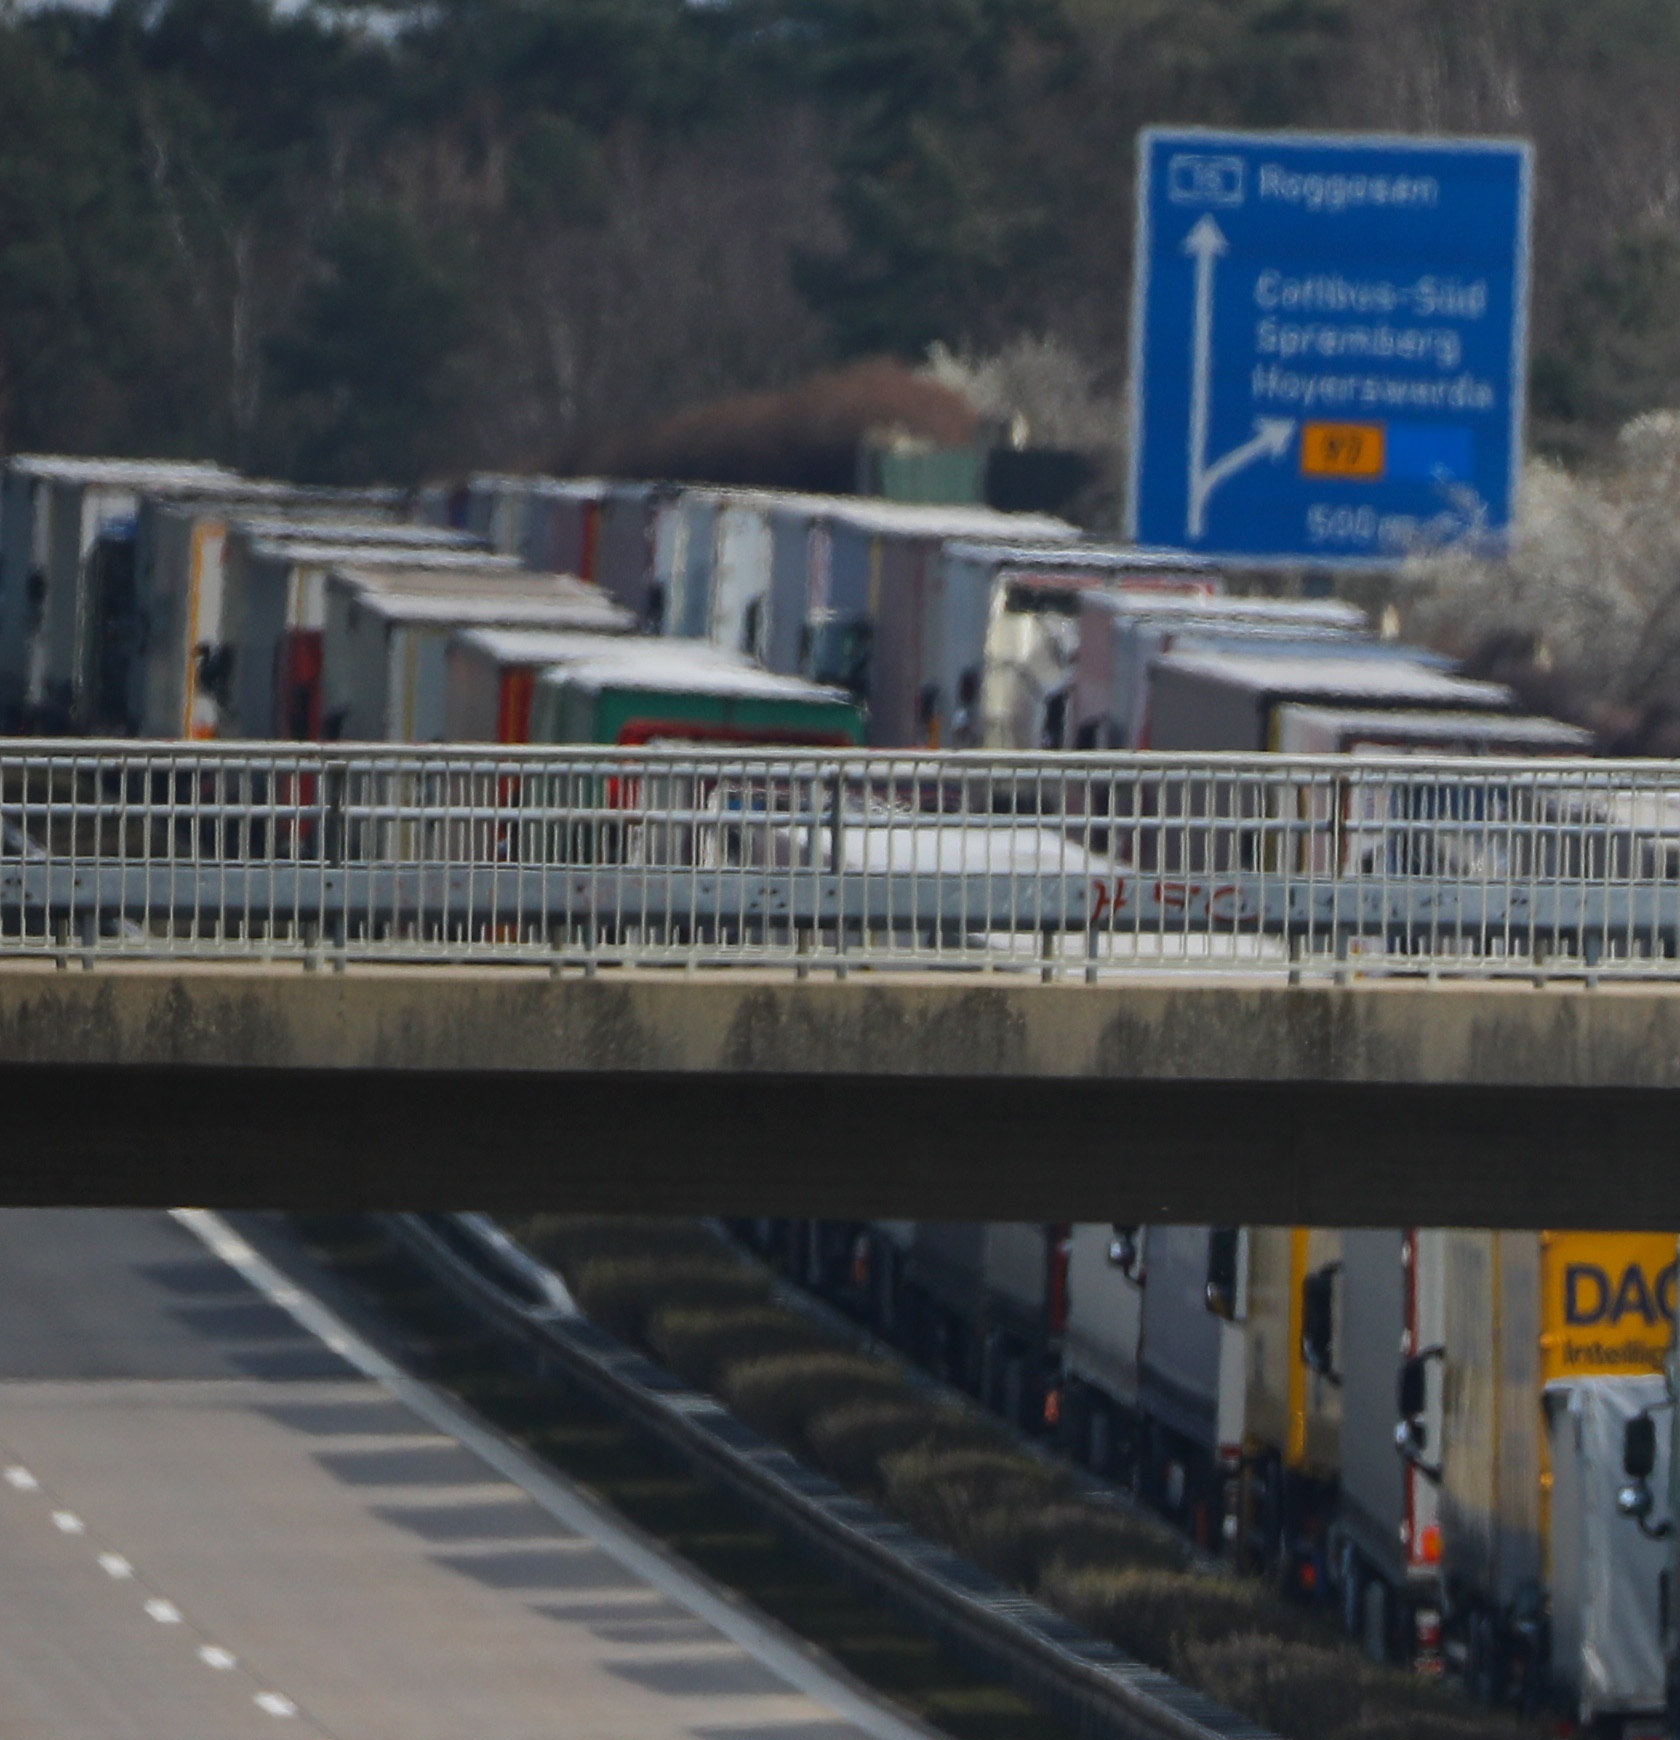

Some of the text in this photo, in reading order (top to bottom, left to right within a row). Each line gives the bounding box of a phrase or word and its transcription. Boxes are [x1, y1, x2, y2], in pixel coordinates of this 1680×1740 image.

[1254, 269, 1488, 319] Cottbus-Süd
[1256, 319, 1460, 368] Spremberg
[1252, 365, 1494, 407] Hoyerswerda
[1305, 503, 1373, 543] 500
